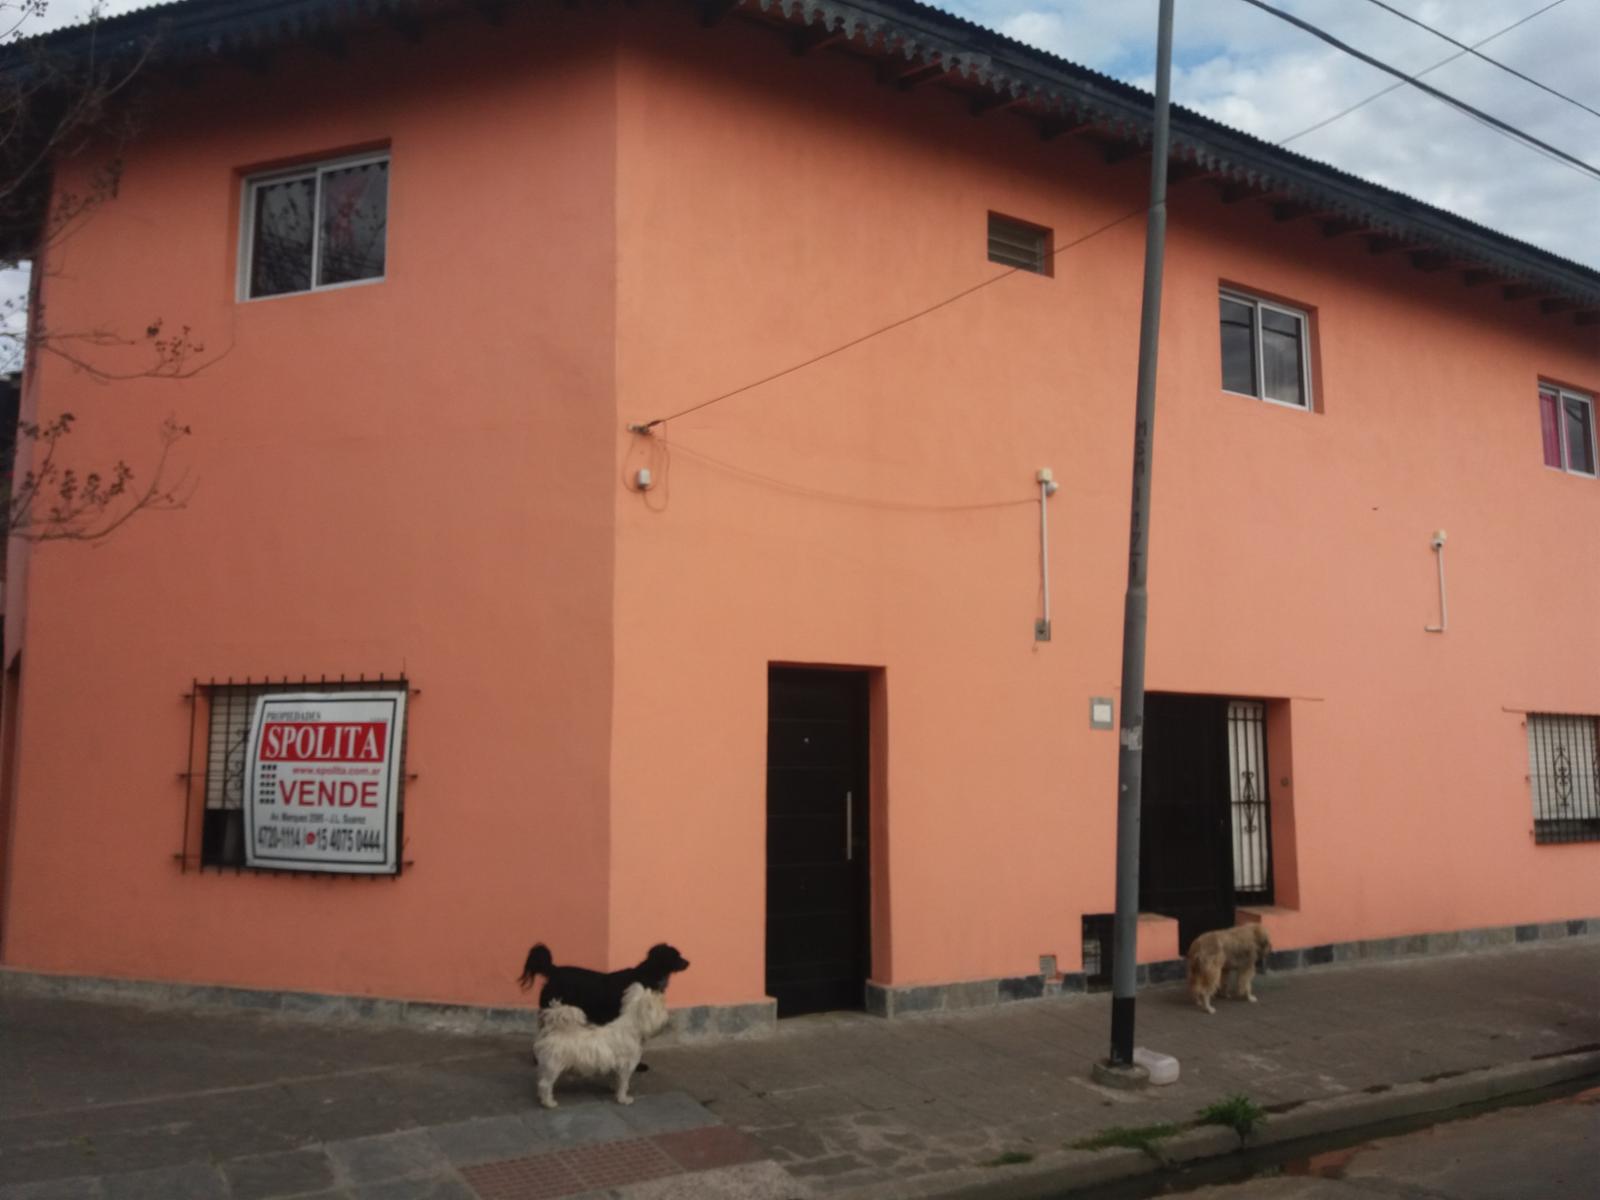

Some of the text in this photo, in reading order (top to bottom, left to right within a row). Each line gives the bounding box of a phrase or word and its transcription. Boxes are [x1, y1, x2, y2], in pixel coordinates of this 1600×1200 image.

[266, 711, 321, 721] PROPIEDADES
[265, 725, 380, 759] SPOLITA
[292, 766, 381, 776] www.spolita.com.ar
[279, 779, 379, 808] VENDE
[355, 829, 381, 853] 0444
